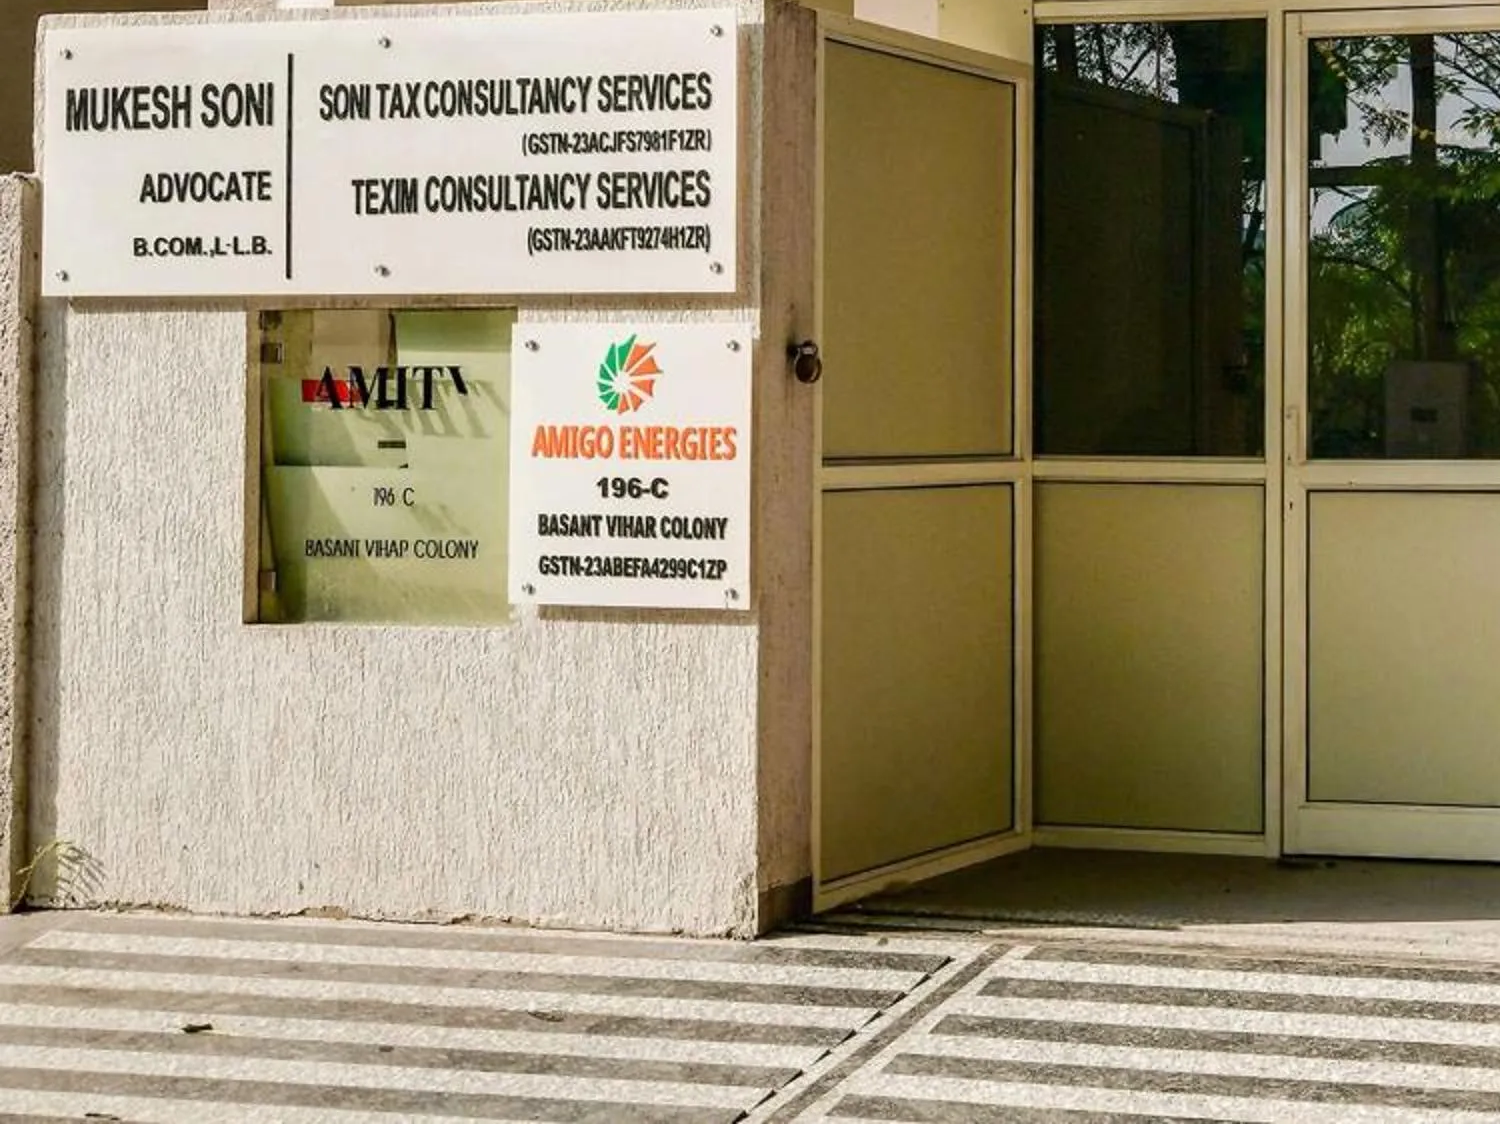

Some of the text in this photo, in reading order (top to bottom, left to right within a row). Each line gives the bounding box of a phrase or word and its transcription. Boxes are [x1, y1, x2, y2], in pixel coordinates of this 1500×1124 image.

[65, 82, 274, 132] MUKESH SONI
[319, 72, 712, 121] SONI TAX CONSULTANCY SERVICES
[139, 171, 272, 203] ADVOCATE
[352, 170, 711, 215] TEXIM CONSULTANCY SERVICES
[531, 424, 738, 461] AMIGO ENERGIES
[373, 487, 415, 507] 196 C
[597, 477, 669, 499] 196-C
[537, 514, 728, 540] BASANT VIHAR COLONY
[413, 539, 479, 558] COLONY
